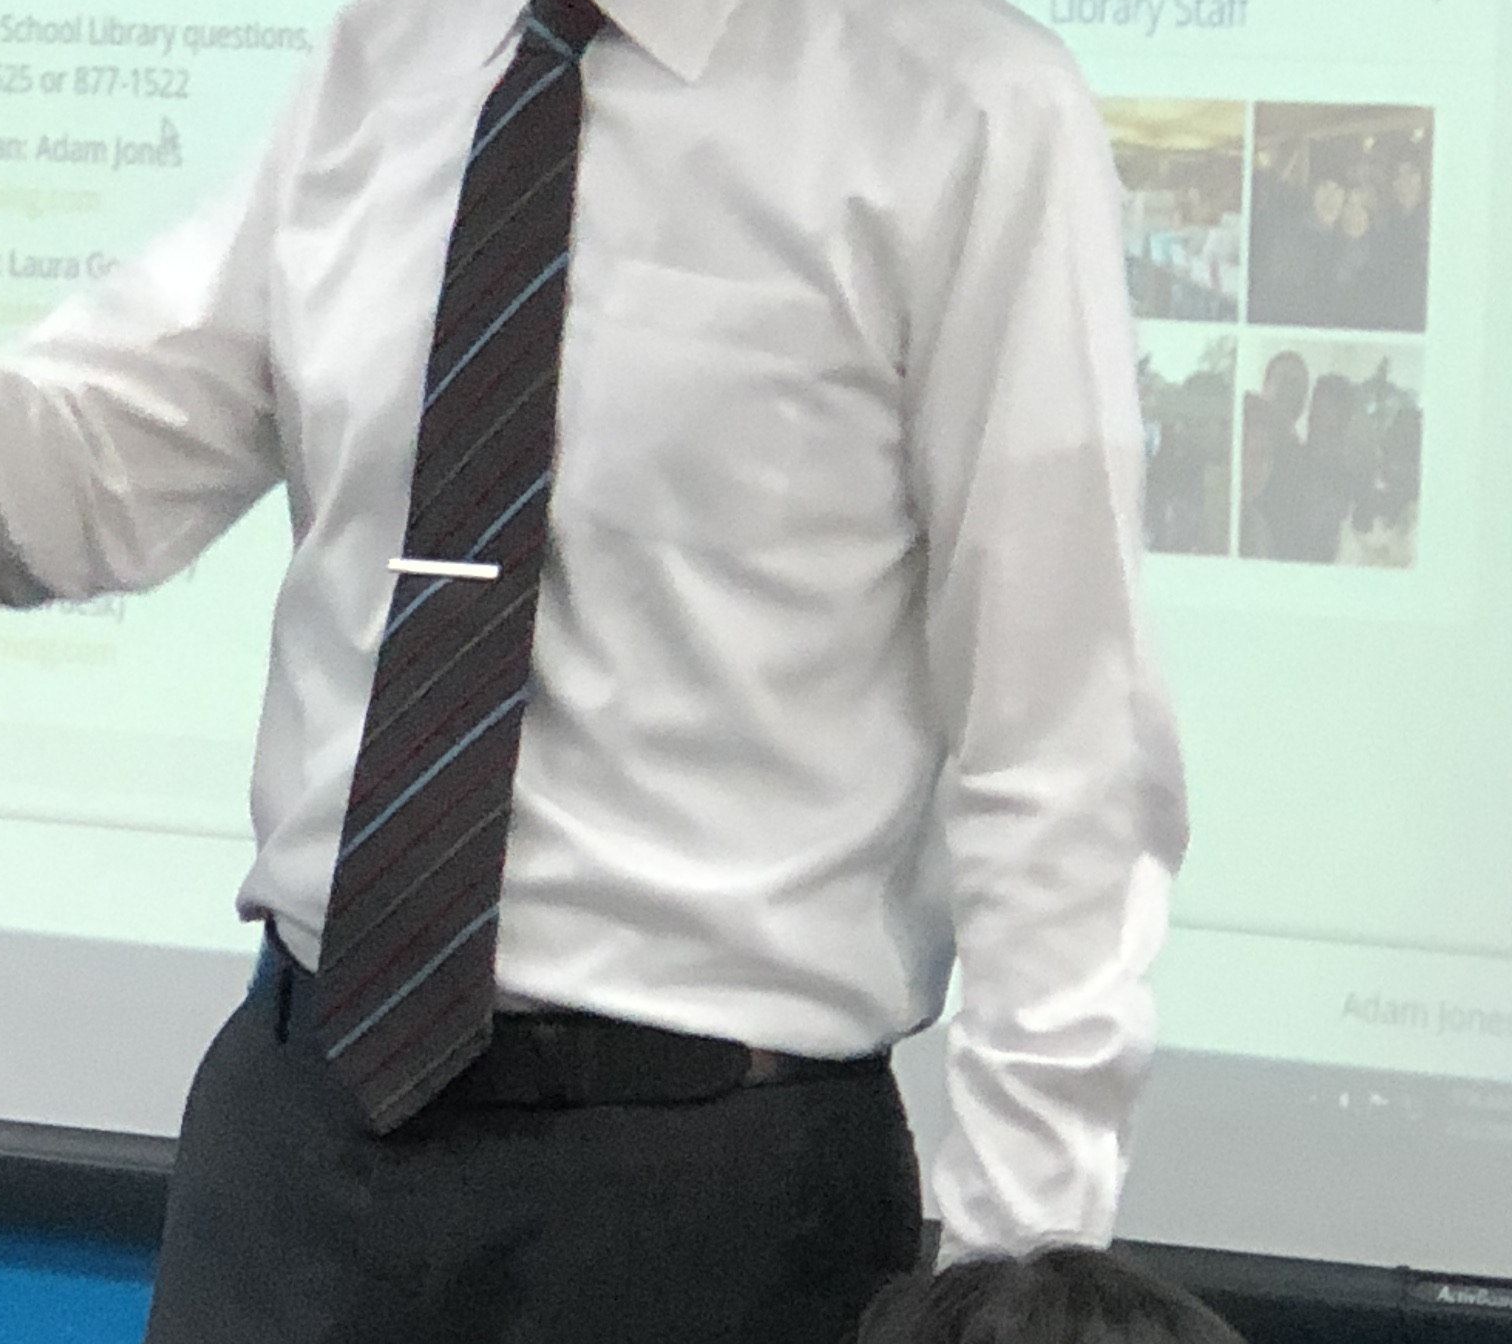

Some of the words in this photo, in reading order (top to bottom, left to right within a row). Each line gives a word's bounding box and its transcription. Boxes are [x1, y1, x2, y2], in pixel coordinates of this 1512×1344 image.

[0, 14, 82, 46] School
[89, 16, 176, 56] Library
[182, 21, 315, 54] questions,
[40, 70, 66, 94] or
[73, 65, 190, 100] 877-1522
[35, 132, 109, 165] Adam
[111, 134, 184, 173] Jones
[9, 247, 81, 281] Laura
[1341, 990, 1429, 1029] Adam
